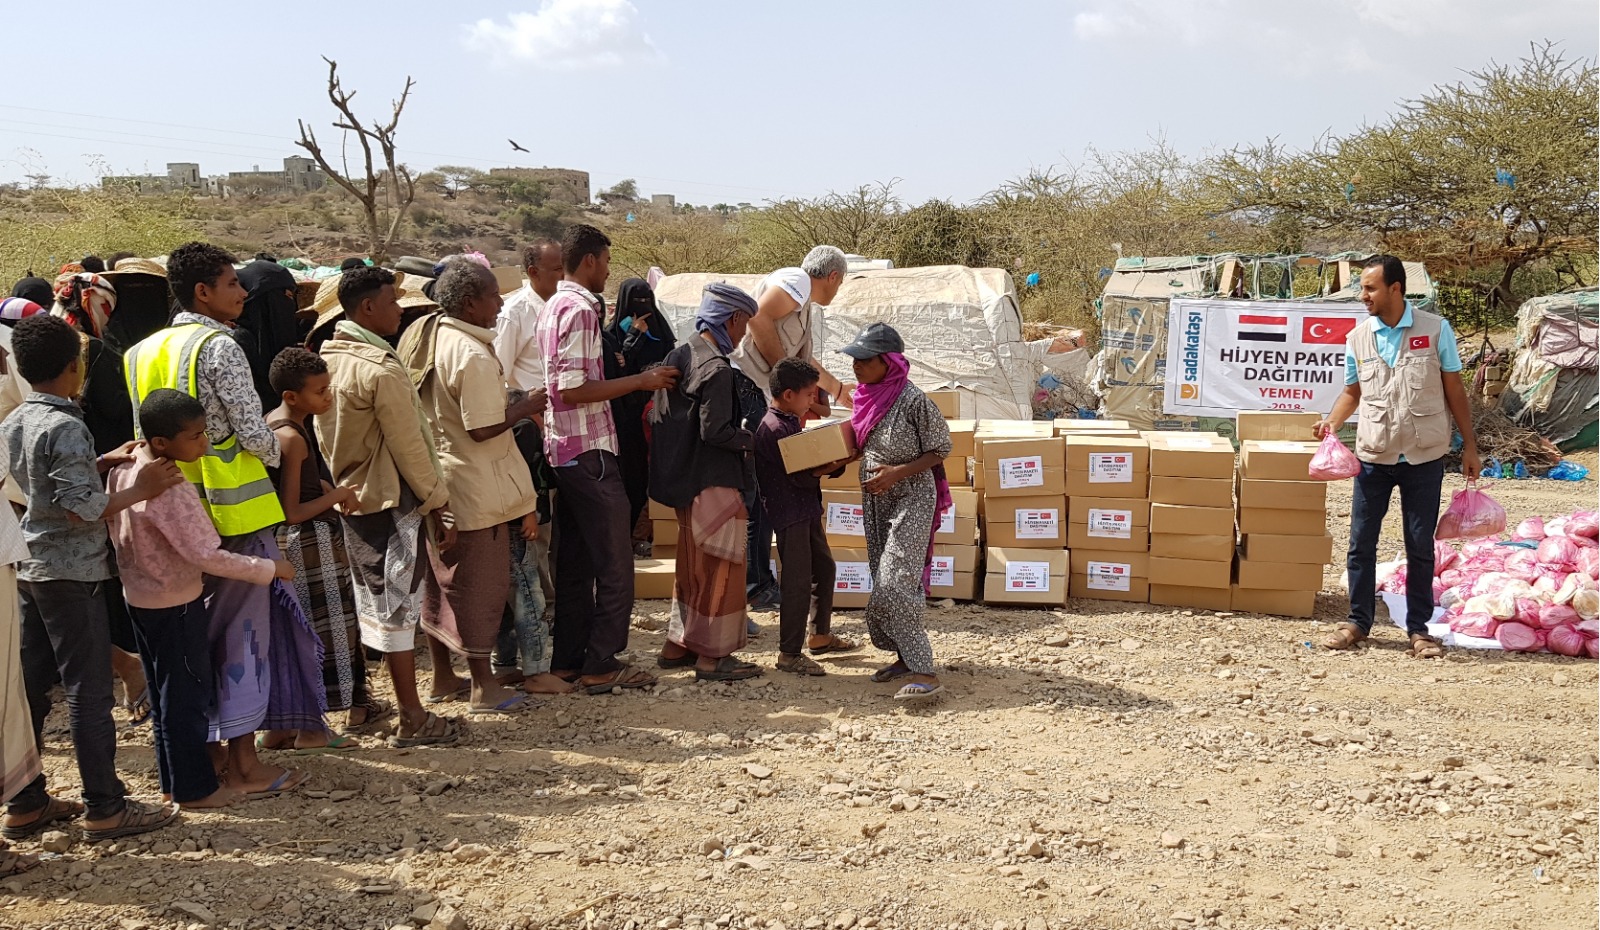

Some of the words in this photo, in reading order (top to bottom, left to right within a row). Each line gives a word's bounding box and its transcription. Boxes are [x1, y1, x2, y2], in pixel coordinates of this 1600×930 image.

[1183, 312, 1203, 381] sadakataşı
[1220, 346, 1289, 365] HİJYEN
[1244, 366, 1333, 384] DAĞITIMI
[1258, 387, 1313, 400] YEMEN
